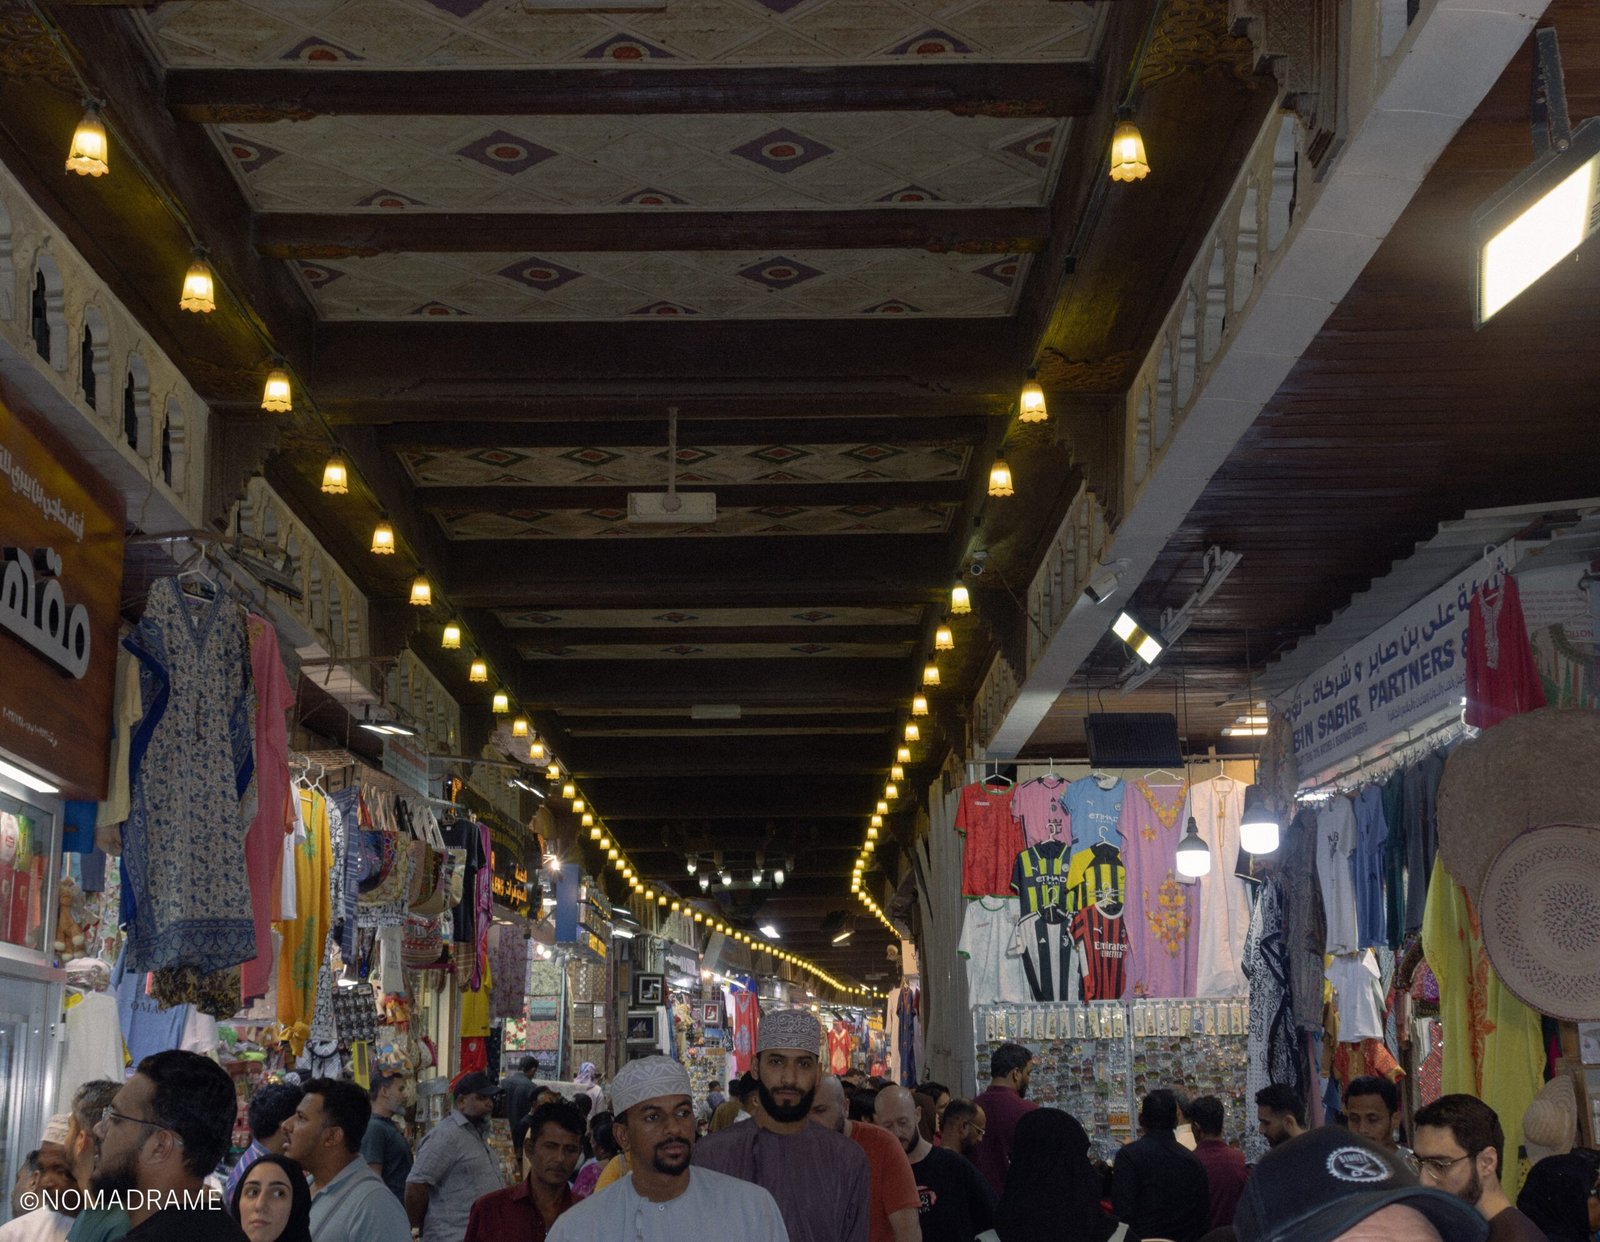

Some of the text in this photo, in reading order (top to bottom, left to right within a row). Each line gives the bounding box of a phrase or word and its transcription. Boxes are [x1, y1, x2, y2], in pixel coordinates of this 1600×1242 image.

[1401, 626, 1418, 656] بن
[1369, 643, 1398, 678] صابر
[1293, 721, 1313, 753] BIN
[1317, 694, 1362, 739] SABIR
[1368, 639, 1454, 711] PARTNERS
[1094, 941, 1127, 951] Emirates
